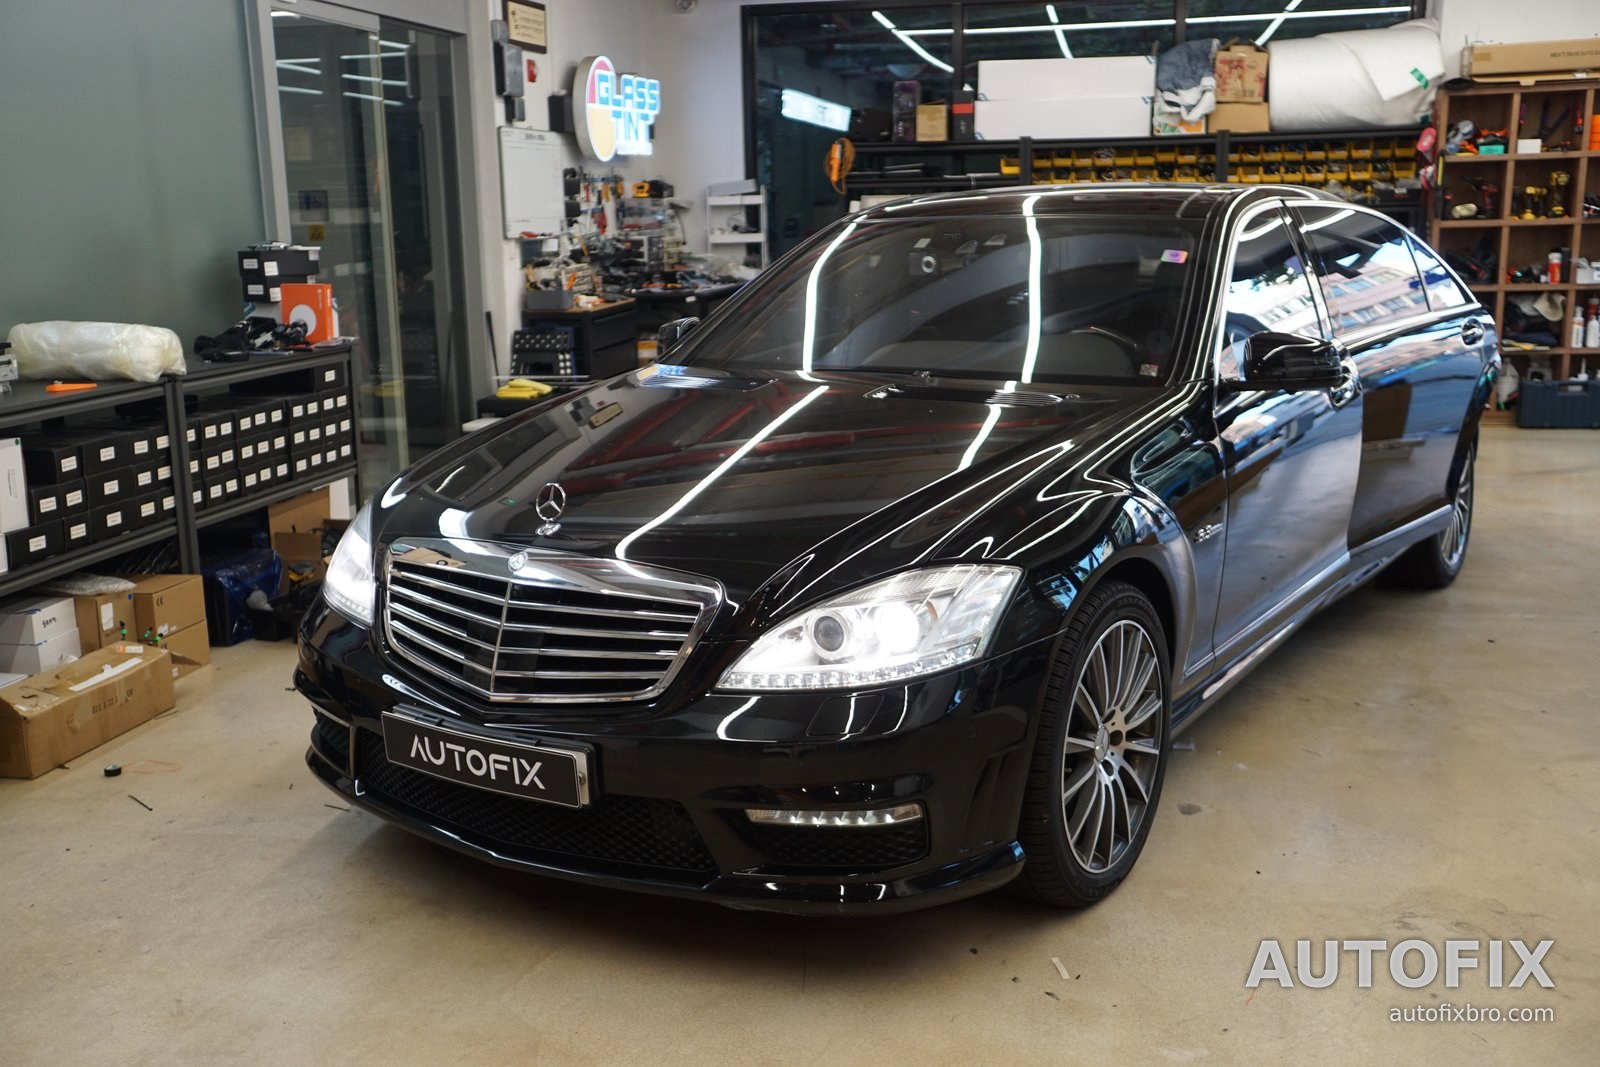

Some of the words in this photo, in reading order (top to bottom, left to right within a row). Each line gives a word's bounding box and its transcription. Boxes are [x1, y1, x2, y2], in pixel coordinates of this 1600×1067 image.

[596, 71, 659, 113] GLASS
[611, 108, 655, 141] TINT
[410, 734, 546, 790] AUTOFIX
